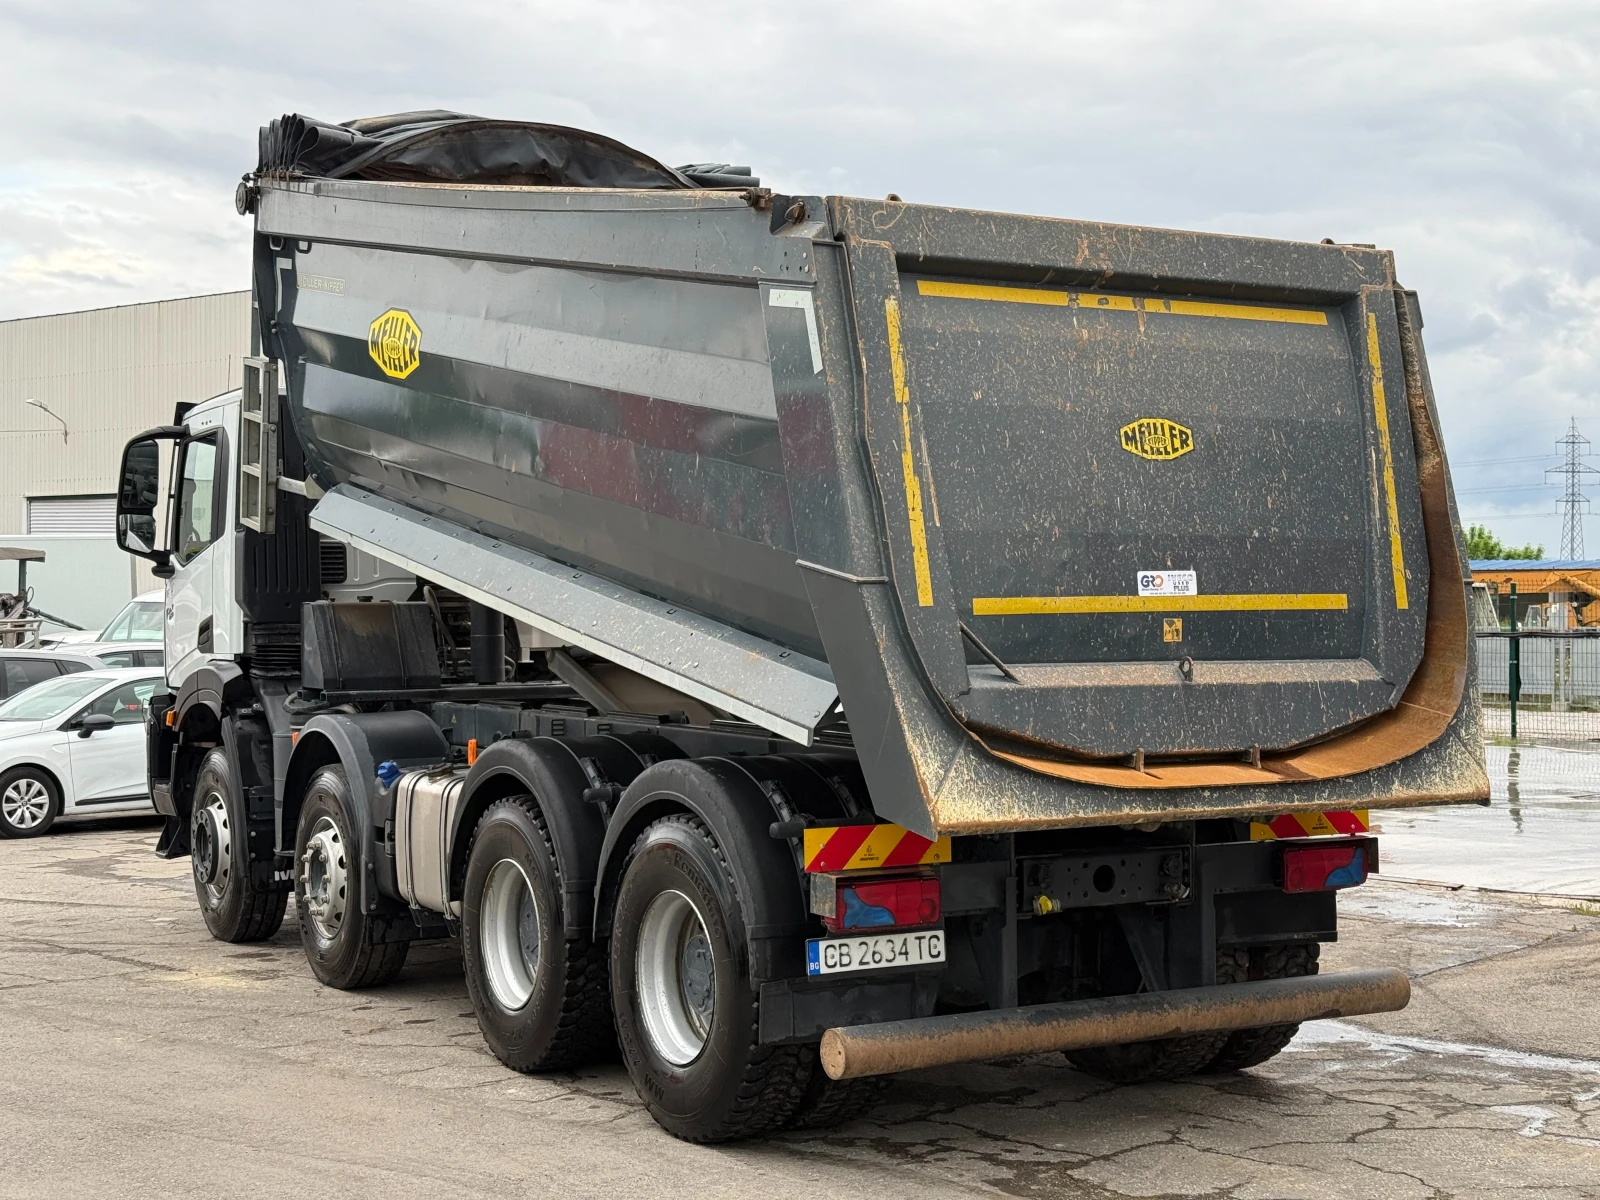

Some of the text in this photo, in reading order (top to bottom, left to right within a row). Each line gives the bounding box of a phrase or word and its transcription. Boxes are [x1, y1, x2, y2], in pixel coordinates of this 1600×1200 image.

[370, 316, 418, 373] MEILLER
[1123, 422, 1191, 455] MEILLER
[809, 962, 820, 970] BG
[824, 934, 941, 968] CB 2634 TC
